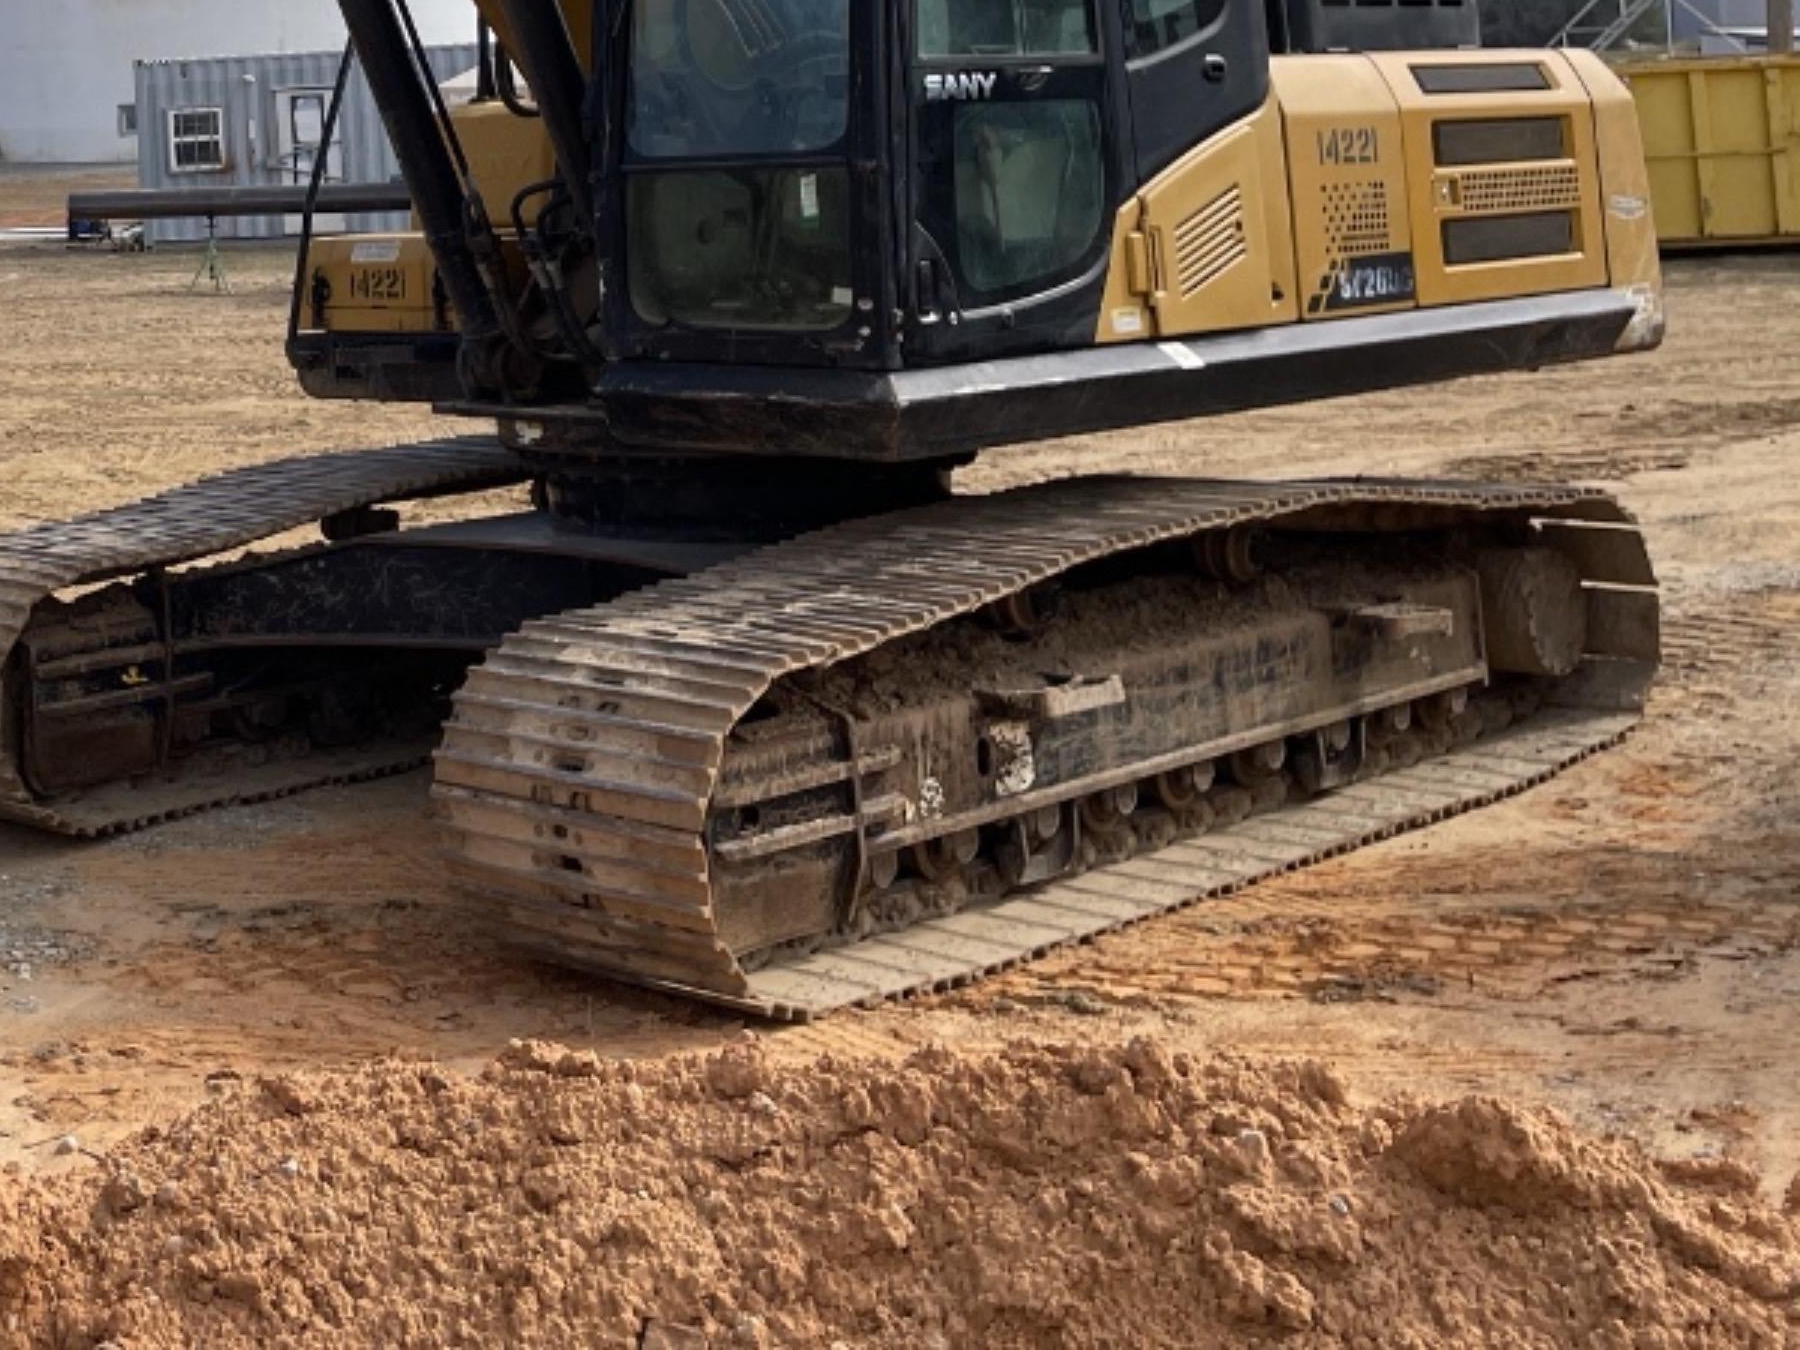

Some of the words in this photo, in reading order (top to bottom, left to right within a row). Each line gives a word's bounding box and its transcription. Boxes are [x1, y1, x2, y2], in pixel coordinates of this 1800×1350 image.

[923, 70, 997, 100] SANY
[1316, 125, 1378, 166] 14221
[349, 266, 407, 299] 14221
